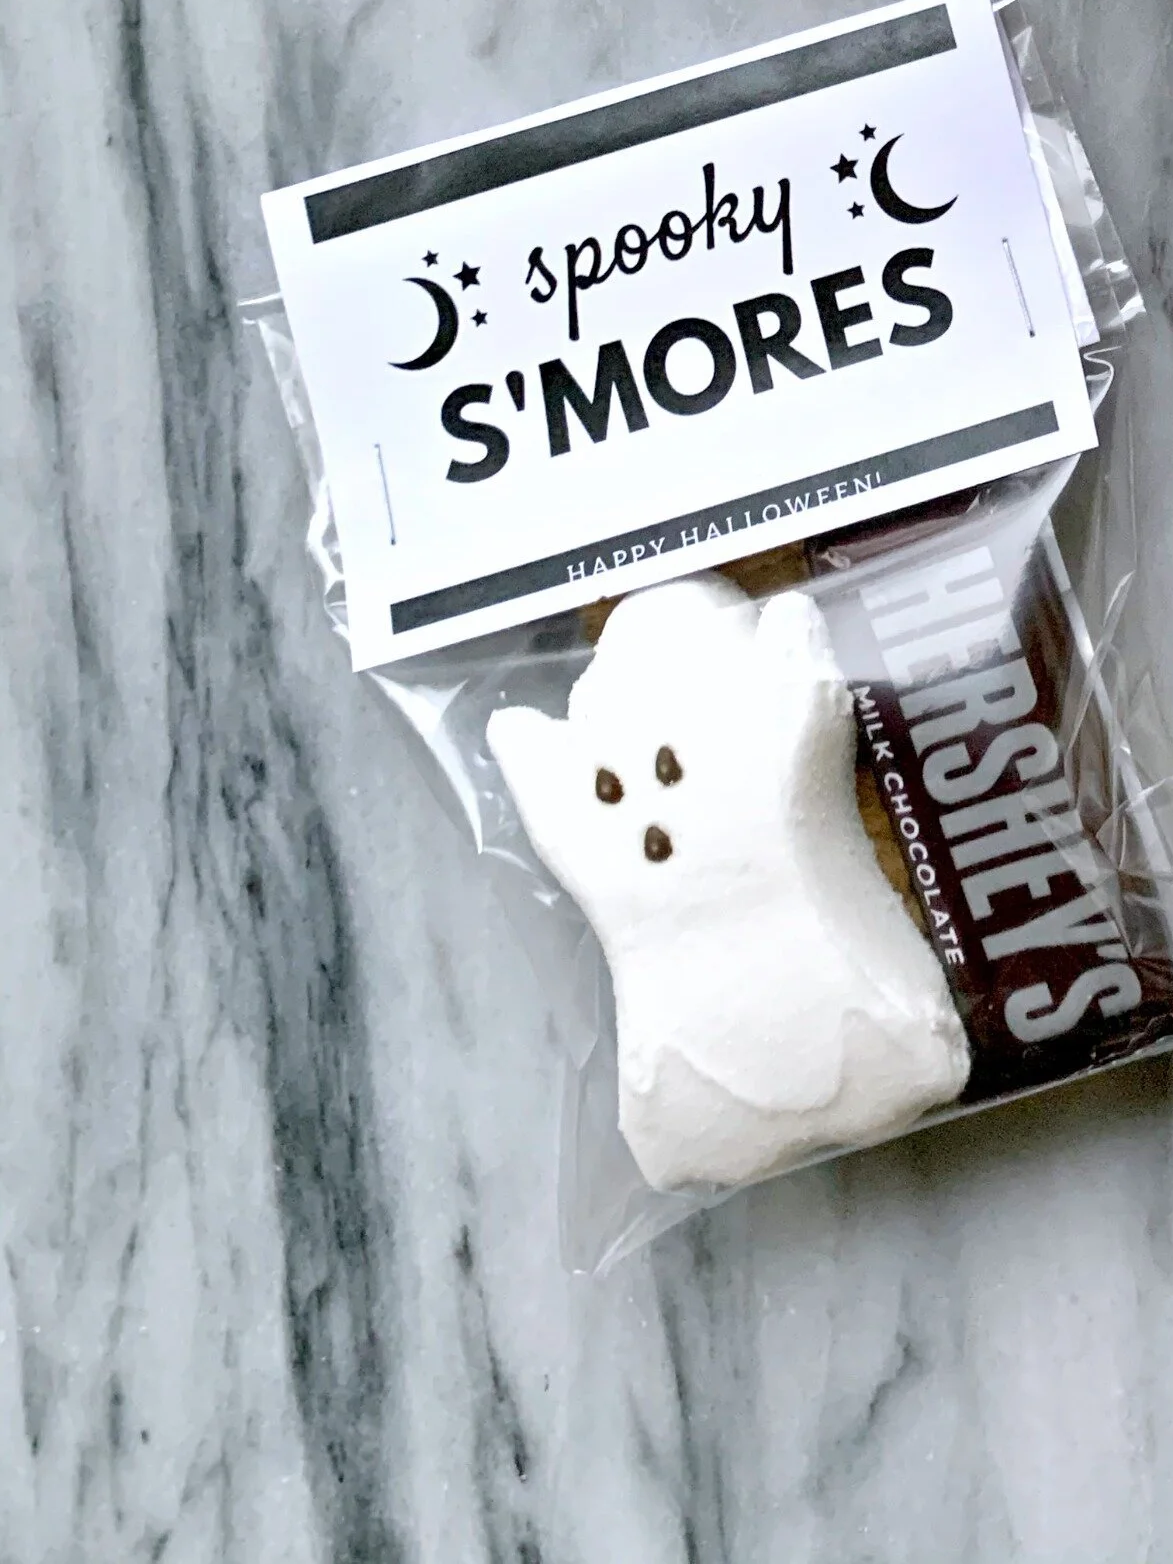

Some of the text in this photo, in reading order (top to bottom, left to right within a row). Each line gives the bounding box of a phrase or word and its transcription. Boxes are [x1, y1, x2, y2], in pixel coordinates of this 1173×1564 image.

[441, 247, 954, 485] S'MORES
[524, 162, 796, 341] spooky
[566, 536, 665, 584] HAPPY
[851, 684, 966, 966] MILK CHOCOLATE
[859, 545, 1142, 1044] HERSHEY'S
